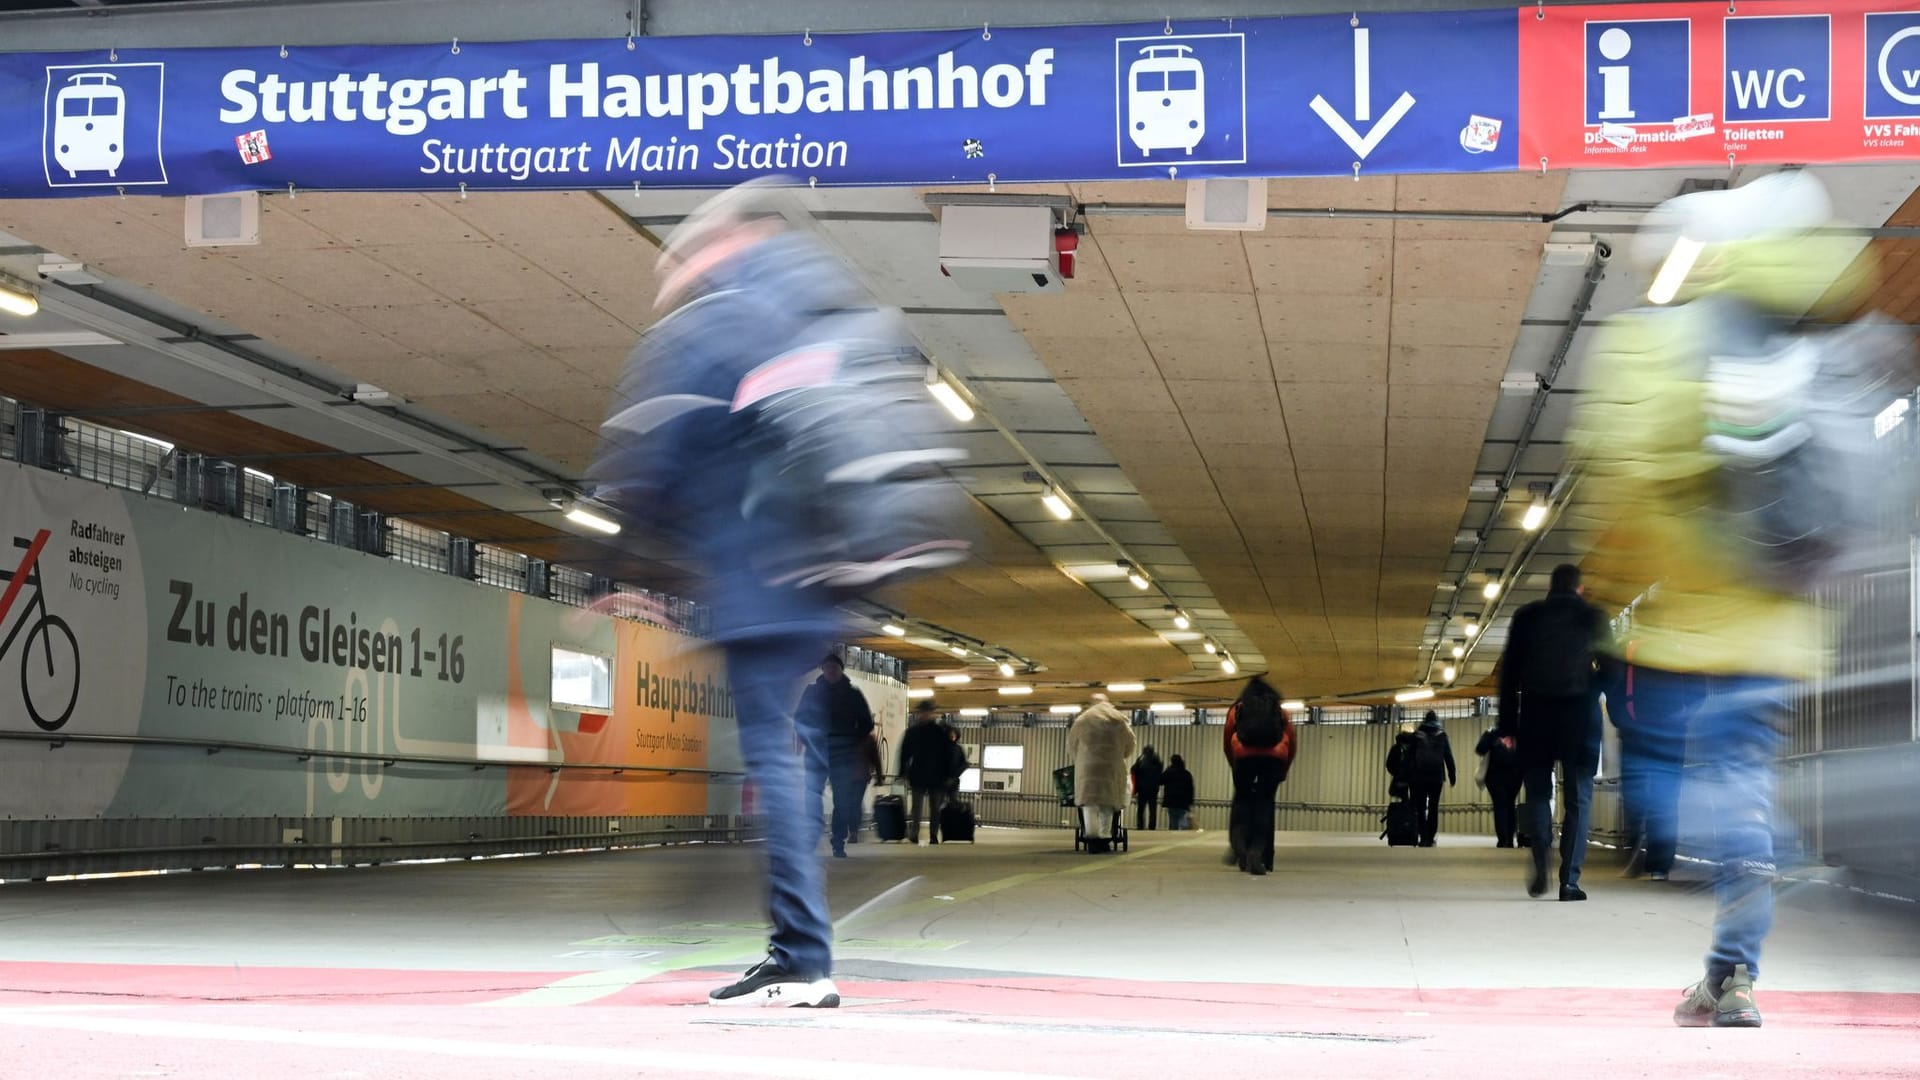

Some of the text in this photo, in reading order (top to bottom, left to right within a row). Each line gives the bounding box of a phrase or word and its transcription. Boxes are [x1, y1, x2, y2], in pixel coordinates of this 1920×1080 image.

[219, 47, 1054, 136] Stuttgart Hauptbahnhof
[1731, 68, 1806, 109] WC
[1584, 132, 1604, 144] DB
[1723, 128, 1784, 141] Toiletten
[1863, 123, 1920, 137] VVS Fah
[1863, 138, 1905, 148] VVS tickets
[420, 132, 848, 181] Stuttgart Main Station
[1630, 144, 1647, 153] desk
[1723, 143, 1747, 151] Toilets
[70, 519, 126, 547] Radfahrer
[68, 545, 123, 573] absteigen
[69, 571, 120, 601] No cycling
[167, 579, 216, 648] Zu
[227, 592, 290, 658] den
[299, 605, 402, 675] Gleisen
[167, 675, 186, 707] To
[191, 678, 217, 710] the
[221, 684, 263, 714] trains
[275, 694, 335, 724] platform
[636, 660, 734, 723] Hauptbahnh
[636, 728, 665, 753] Stuttgart
